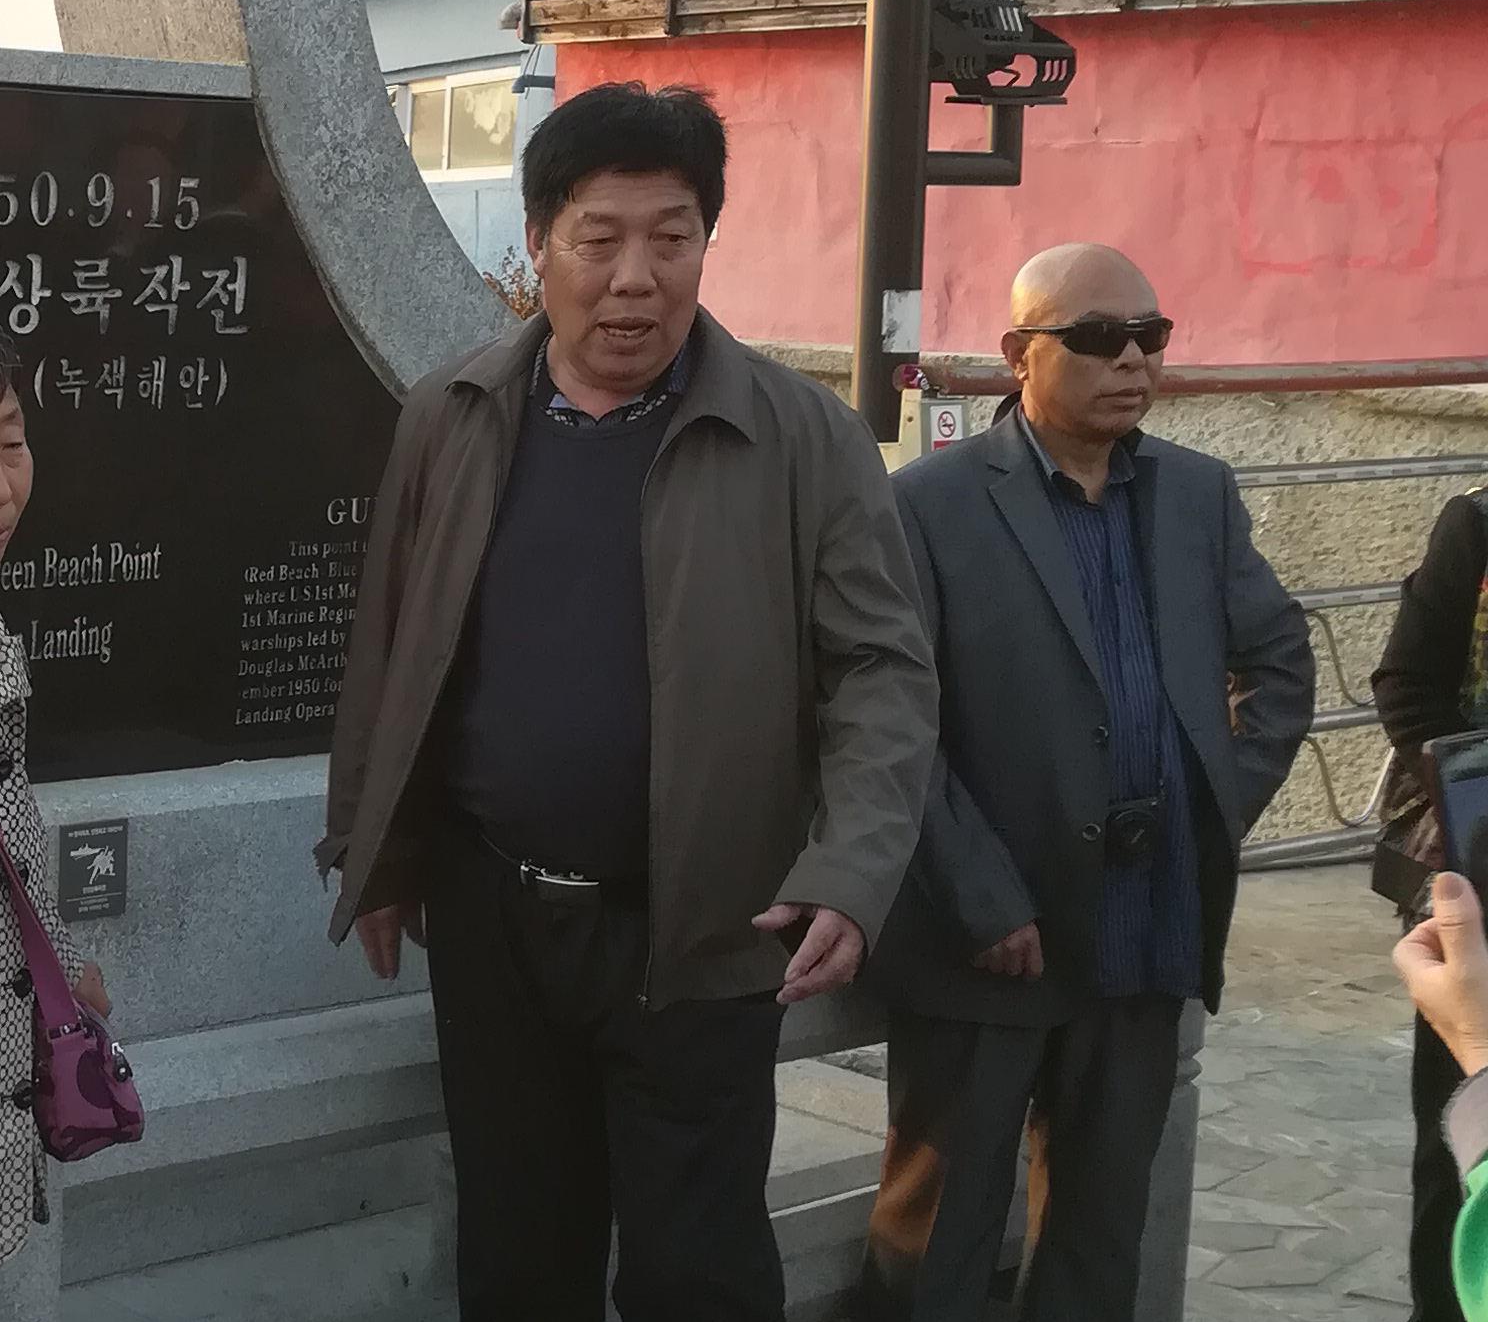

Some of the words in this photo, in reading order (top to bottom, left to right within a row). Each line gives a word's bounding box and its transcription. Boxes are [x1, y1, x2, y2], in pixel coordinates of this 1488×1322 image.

[327, 497, 378, 525] GU
[42, 542, 103, 588] Beach
[108, 541, 163, 583] Point
[266, 608, 315, 627] Marine
[29, 615, 114, 665] Landing
[240, 633, 304, 653] warships
[307, 631, 328, 648] led
[238, 658, 295, 678] Douglas
[287, 677, 321, 697] 1950
[234, 707, 293, 726] Landing
